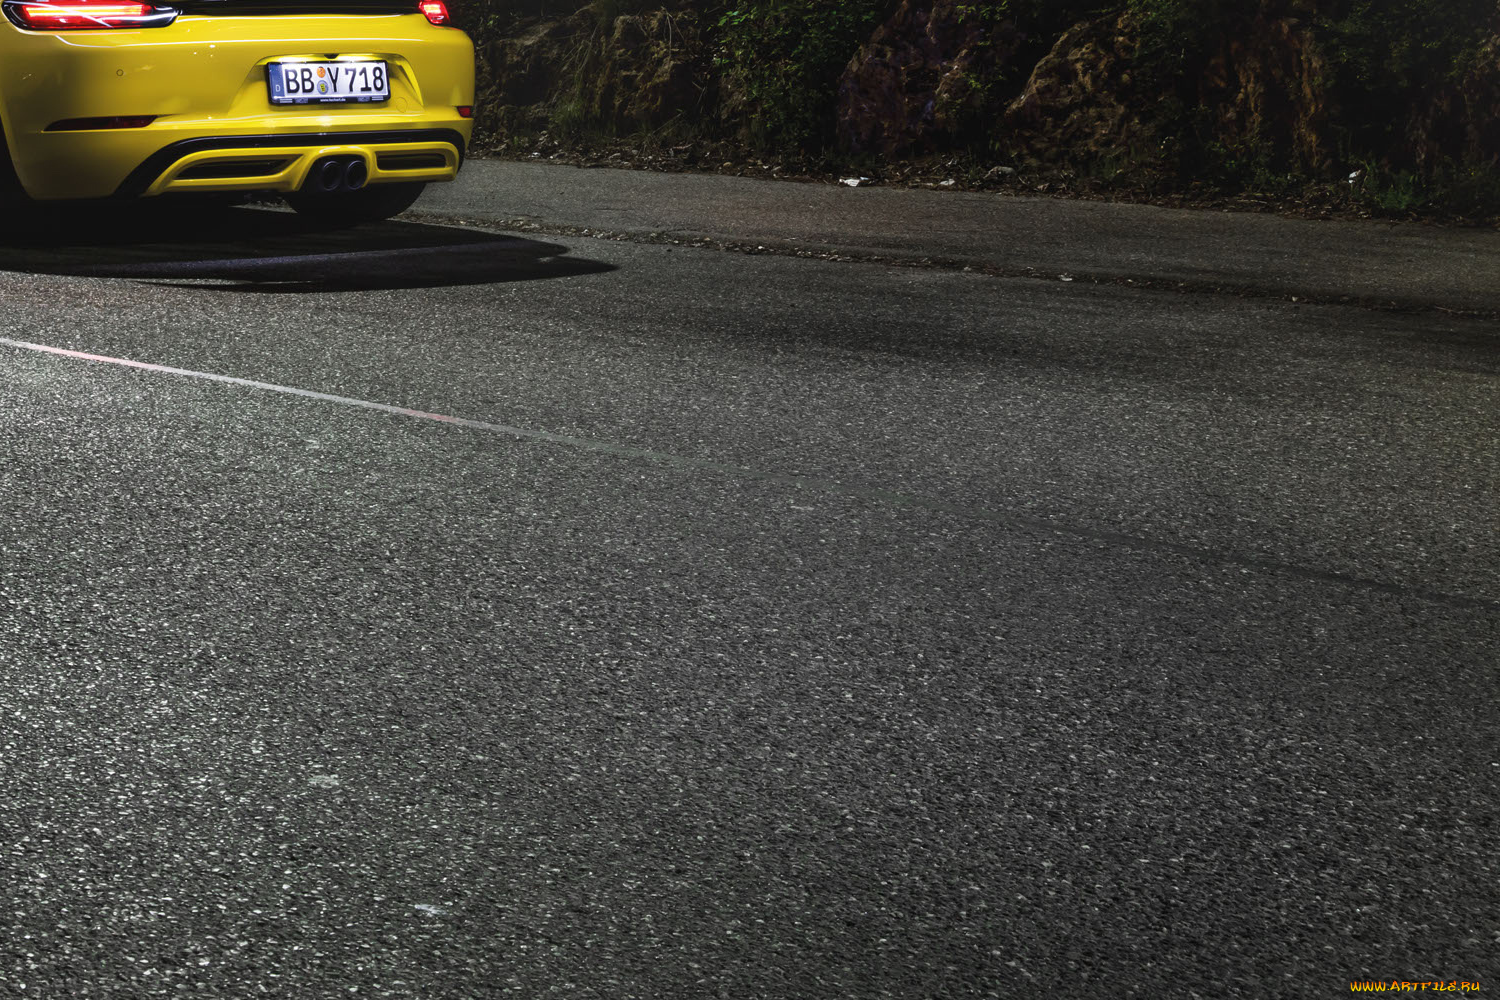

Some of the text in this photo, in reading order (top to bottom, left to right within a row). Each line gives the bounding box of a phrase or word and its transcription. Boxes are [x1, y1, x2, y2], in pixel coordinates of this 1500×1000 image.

[285, 66, 384, 94] BB Y 718
